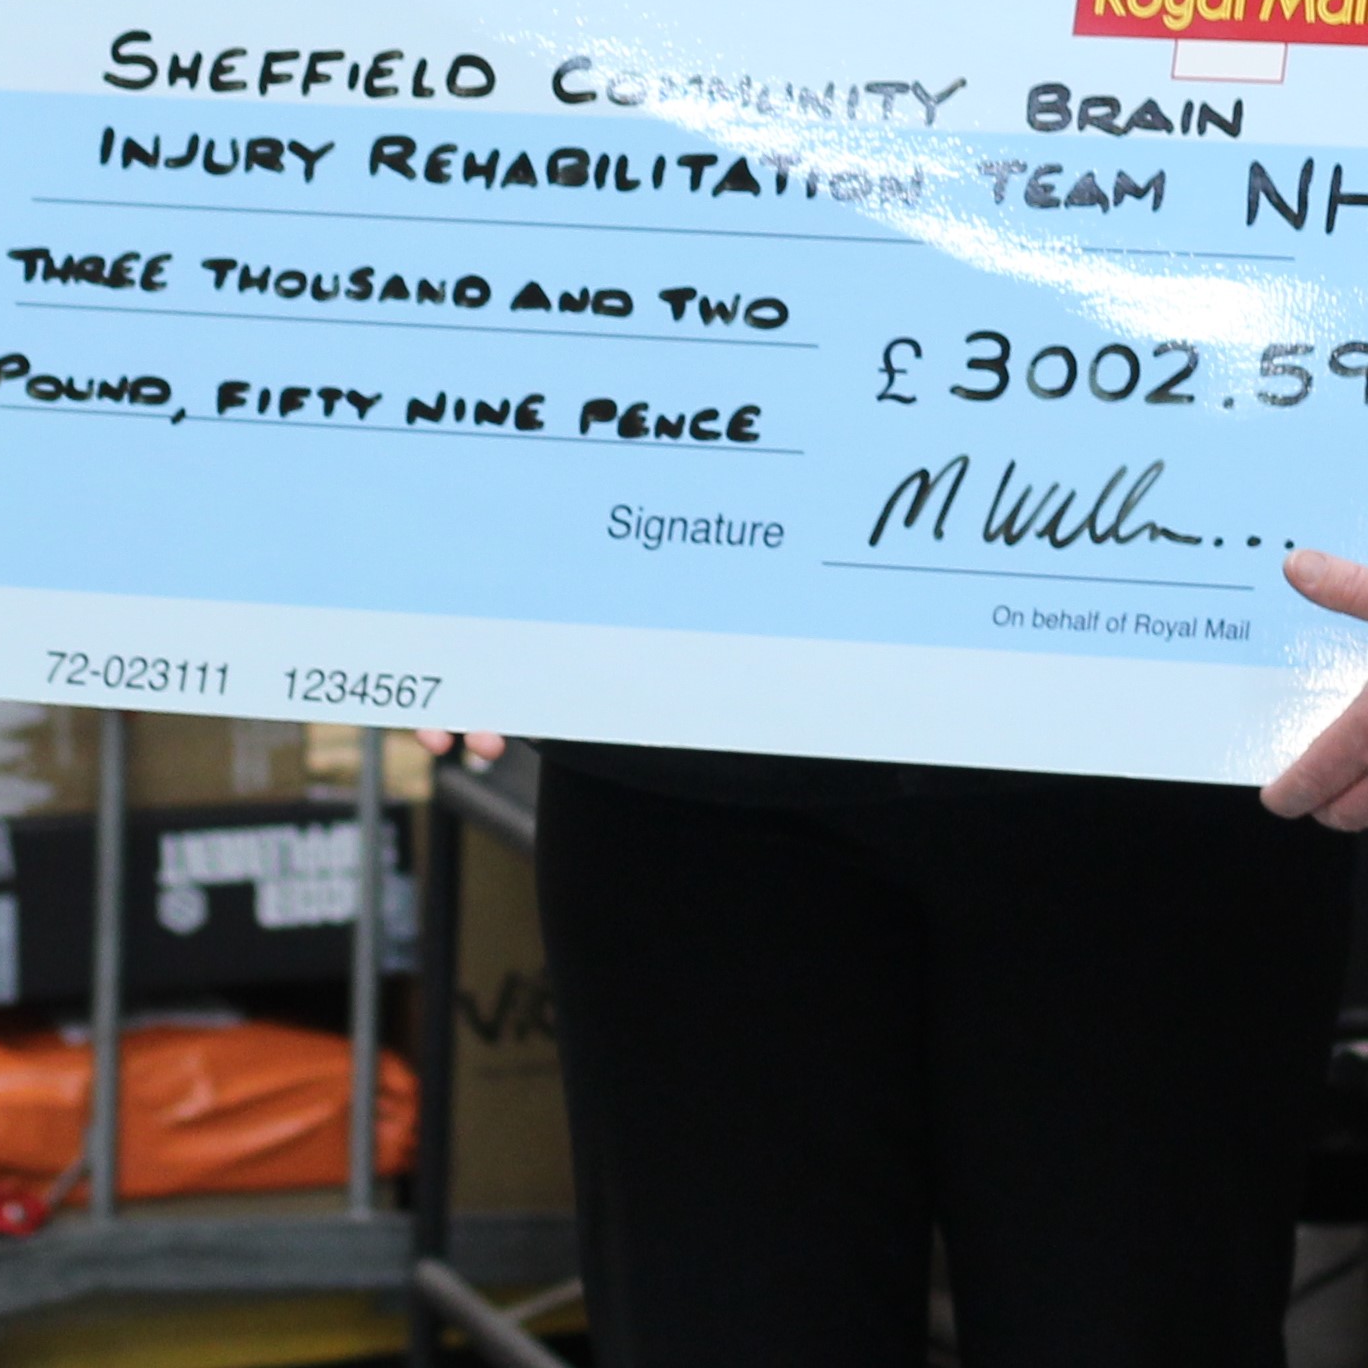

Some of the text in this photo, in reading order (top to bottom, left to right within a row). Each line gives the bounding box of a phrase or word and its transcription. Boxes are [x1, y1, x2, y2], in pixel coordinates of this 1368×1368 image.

[103, 30, 1243, 139] SHEFFIELD COMMUNITY BRAIN
[100, 127, 335, 182] INJURY
[368, 134, 924, 205] REHABILITATION
[978, 158, 1166, 214] TEAM
[8, 247, 791, 331] THREE THOUSAND AND TWO
[216, 380, 382, 421] FIFTY
[405, 390, 546, 433] NINE
[578, 397, 763, 443] PENCE
[606, 503, 786, 552] Signature
[992, 603, 1251, 643] On behalf of Royal Mail
[44, 648, 231, 698] 72-023111
[281, 665, 444, 712] 1234567
